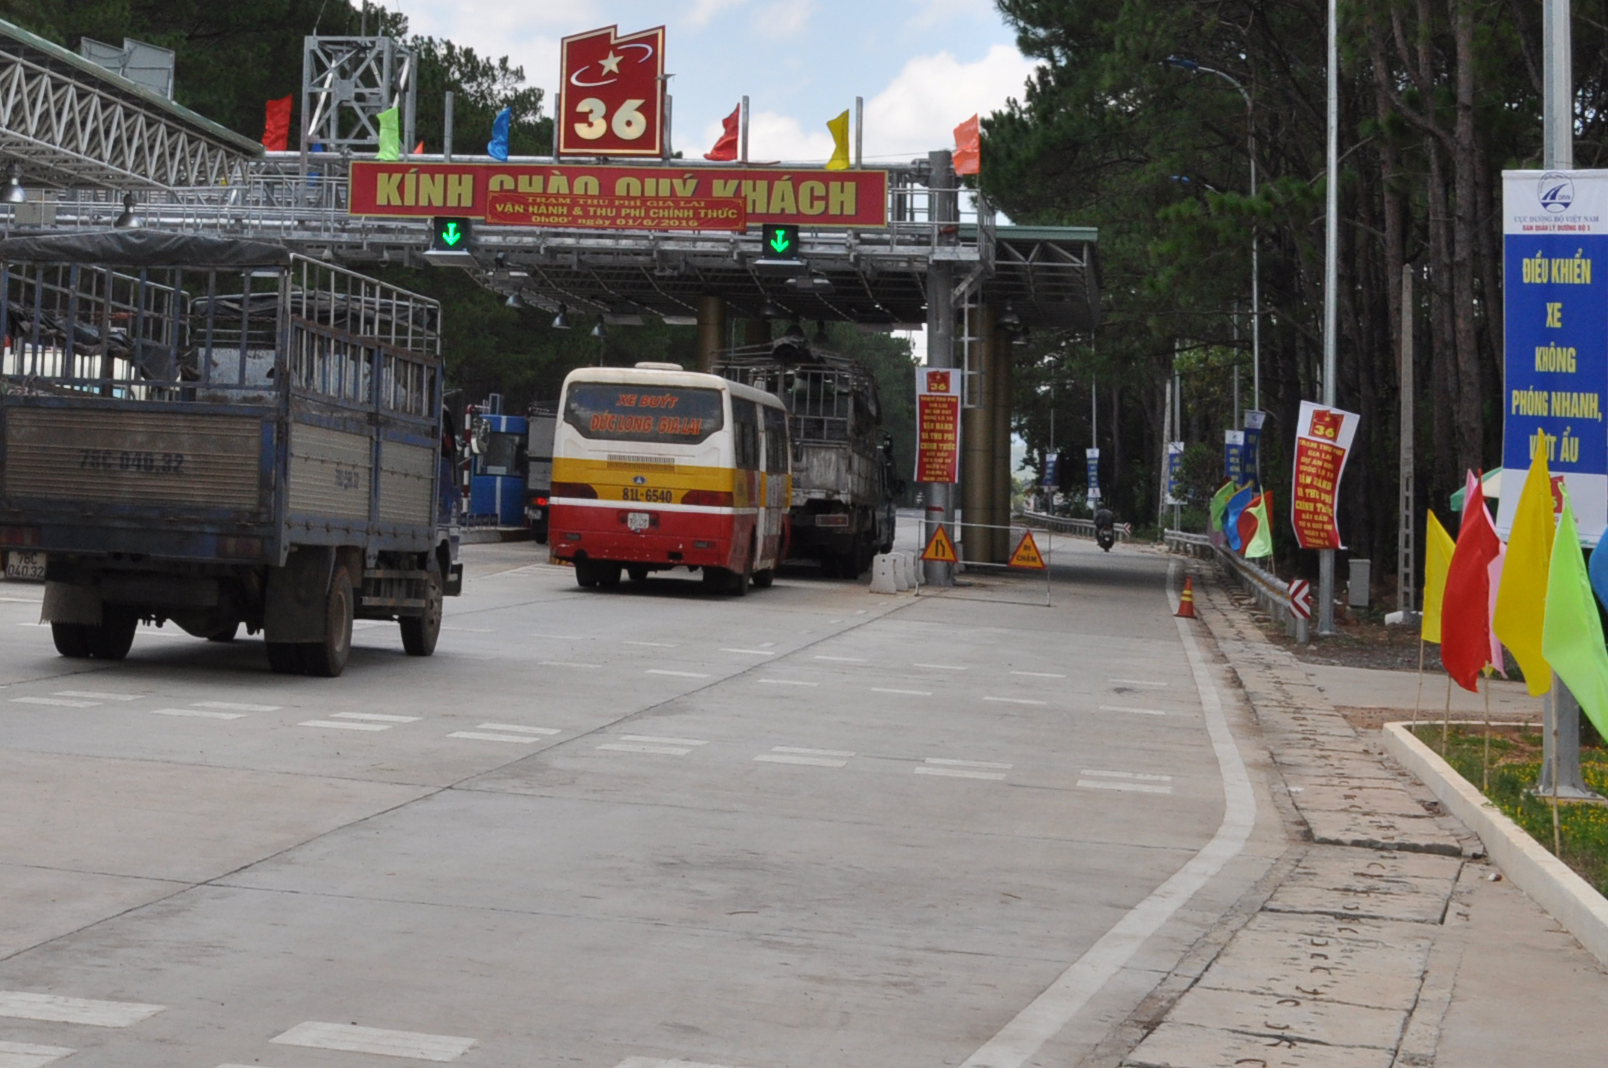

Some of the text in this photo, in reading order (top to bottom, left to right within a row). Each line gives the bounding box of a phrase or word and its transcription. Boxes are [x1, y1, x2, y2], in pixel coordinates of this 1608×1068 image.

[573, 97, 647, 140] 36
[376, 168, 474, 207] KÍNH
[712, 176, 856, 215] KHÁCH
[496, 202, 738, 218] VẬN HÀNH & THU PHÍ CHÍNH THỨC
[578, 217, 611, 225] ngày
[1546, 302, 1562, 328] XE
[1535, 341, 1577, 373] KHÔNG
[616, 393, 678, 408] XE BUÝT
[1512, 385, 1602, 423] PHÓNG NHANH,
[590, 410, 702, 435] ĐỨC LONG GIA LAI
[1314, 425, 1334, 438] 36
[1559, 425, 1580, 463] ẨU
